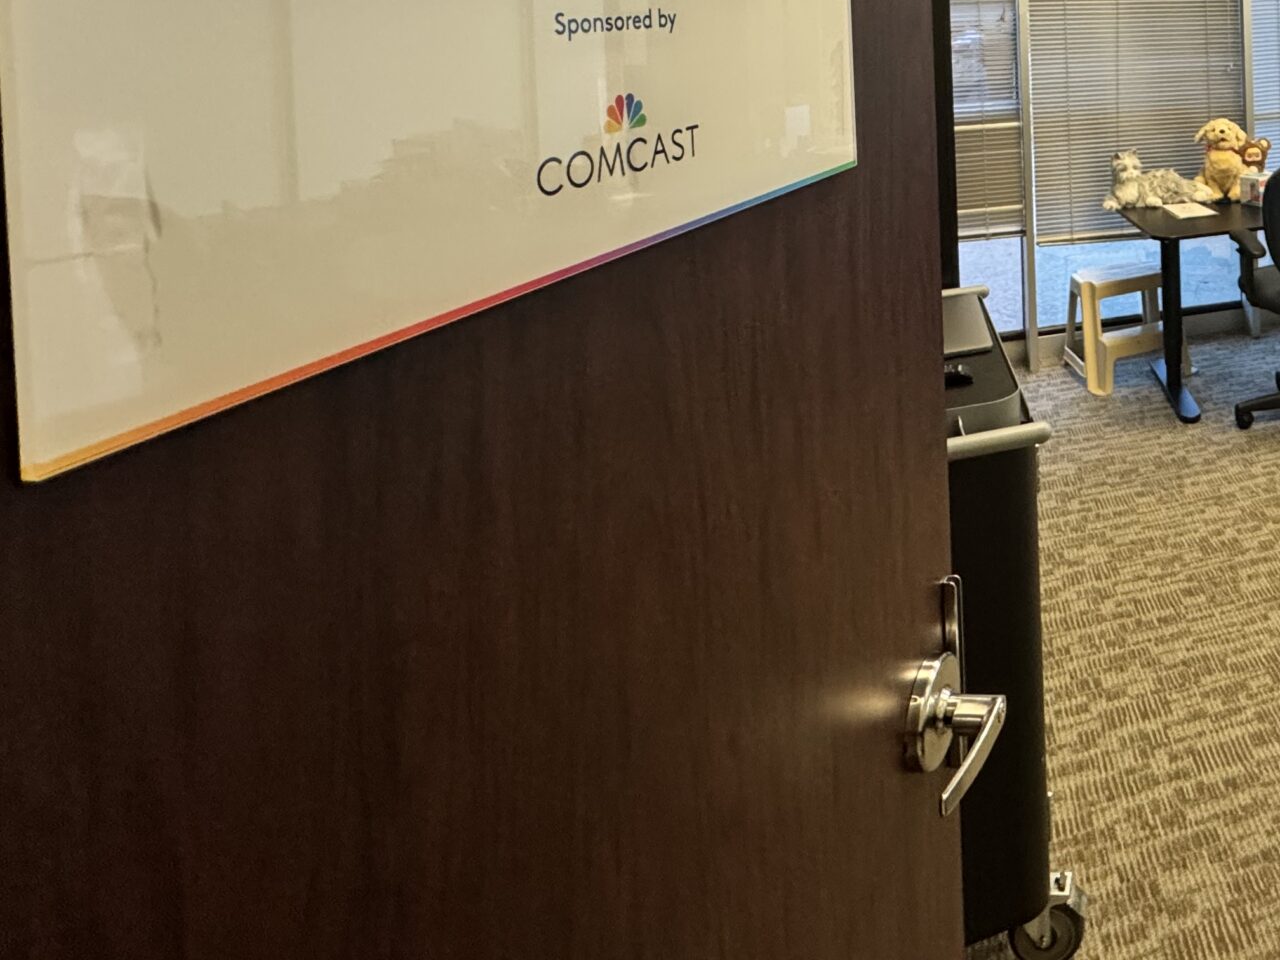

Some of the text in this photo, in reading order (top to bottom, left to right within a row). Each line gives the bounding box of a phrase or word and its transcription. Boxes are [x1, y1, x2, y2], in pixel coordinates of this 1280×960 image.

[554, 8, 677, 41] Sponsored by
[536, 124, 700, 196] COMCAST
